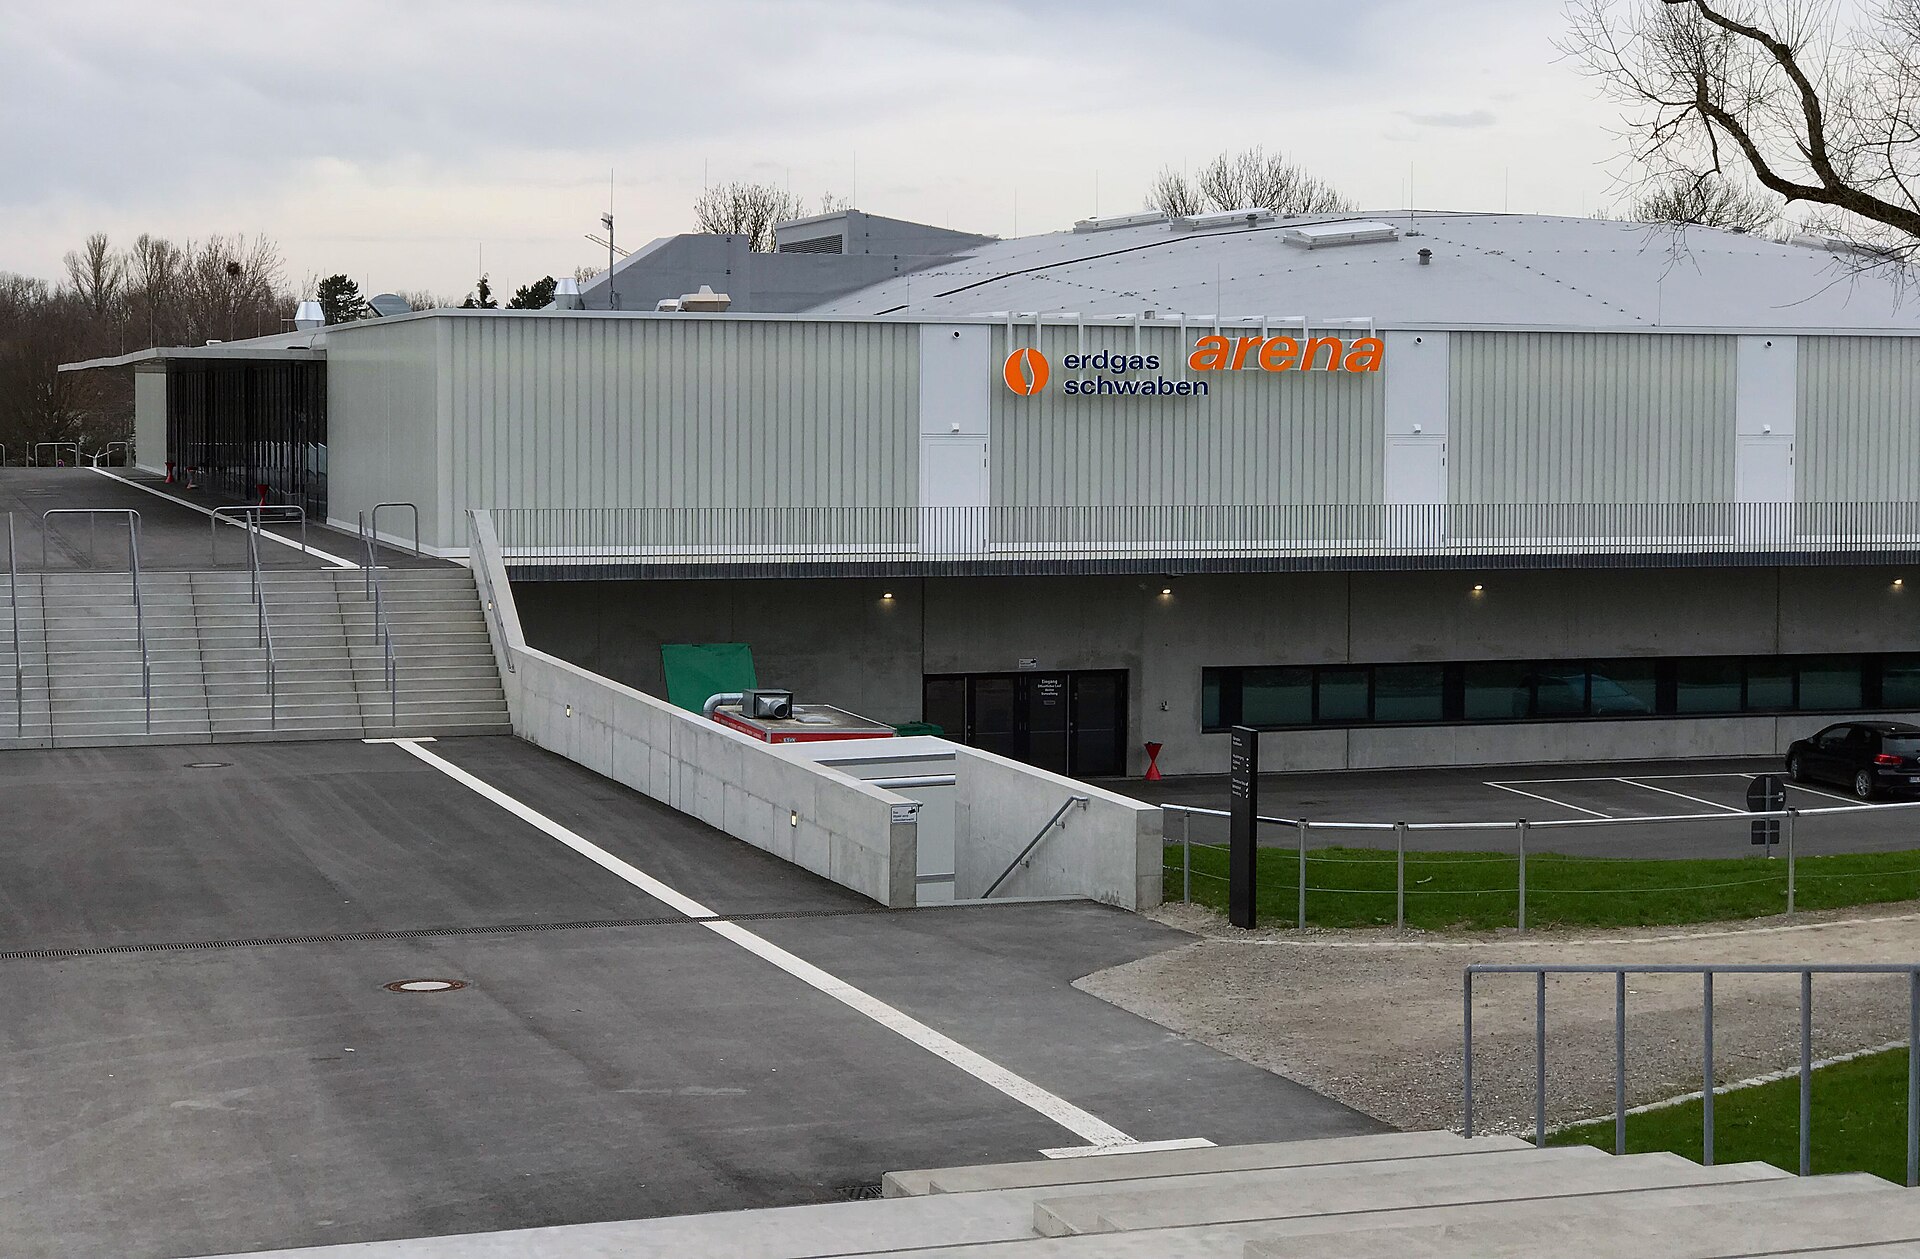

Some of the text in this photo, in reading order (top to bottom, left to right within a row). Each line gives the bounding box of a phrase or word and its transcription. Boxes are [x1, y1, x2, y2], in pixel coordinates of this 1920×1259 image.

[1064, 350, 1160, 370] erdgas
[1188, 335, 1385, 372] arena
[1064, 376, 1209, 396] schwaben
